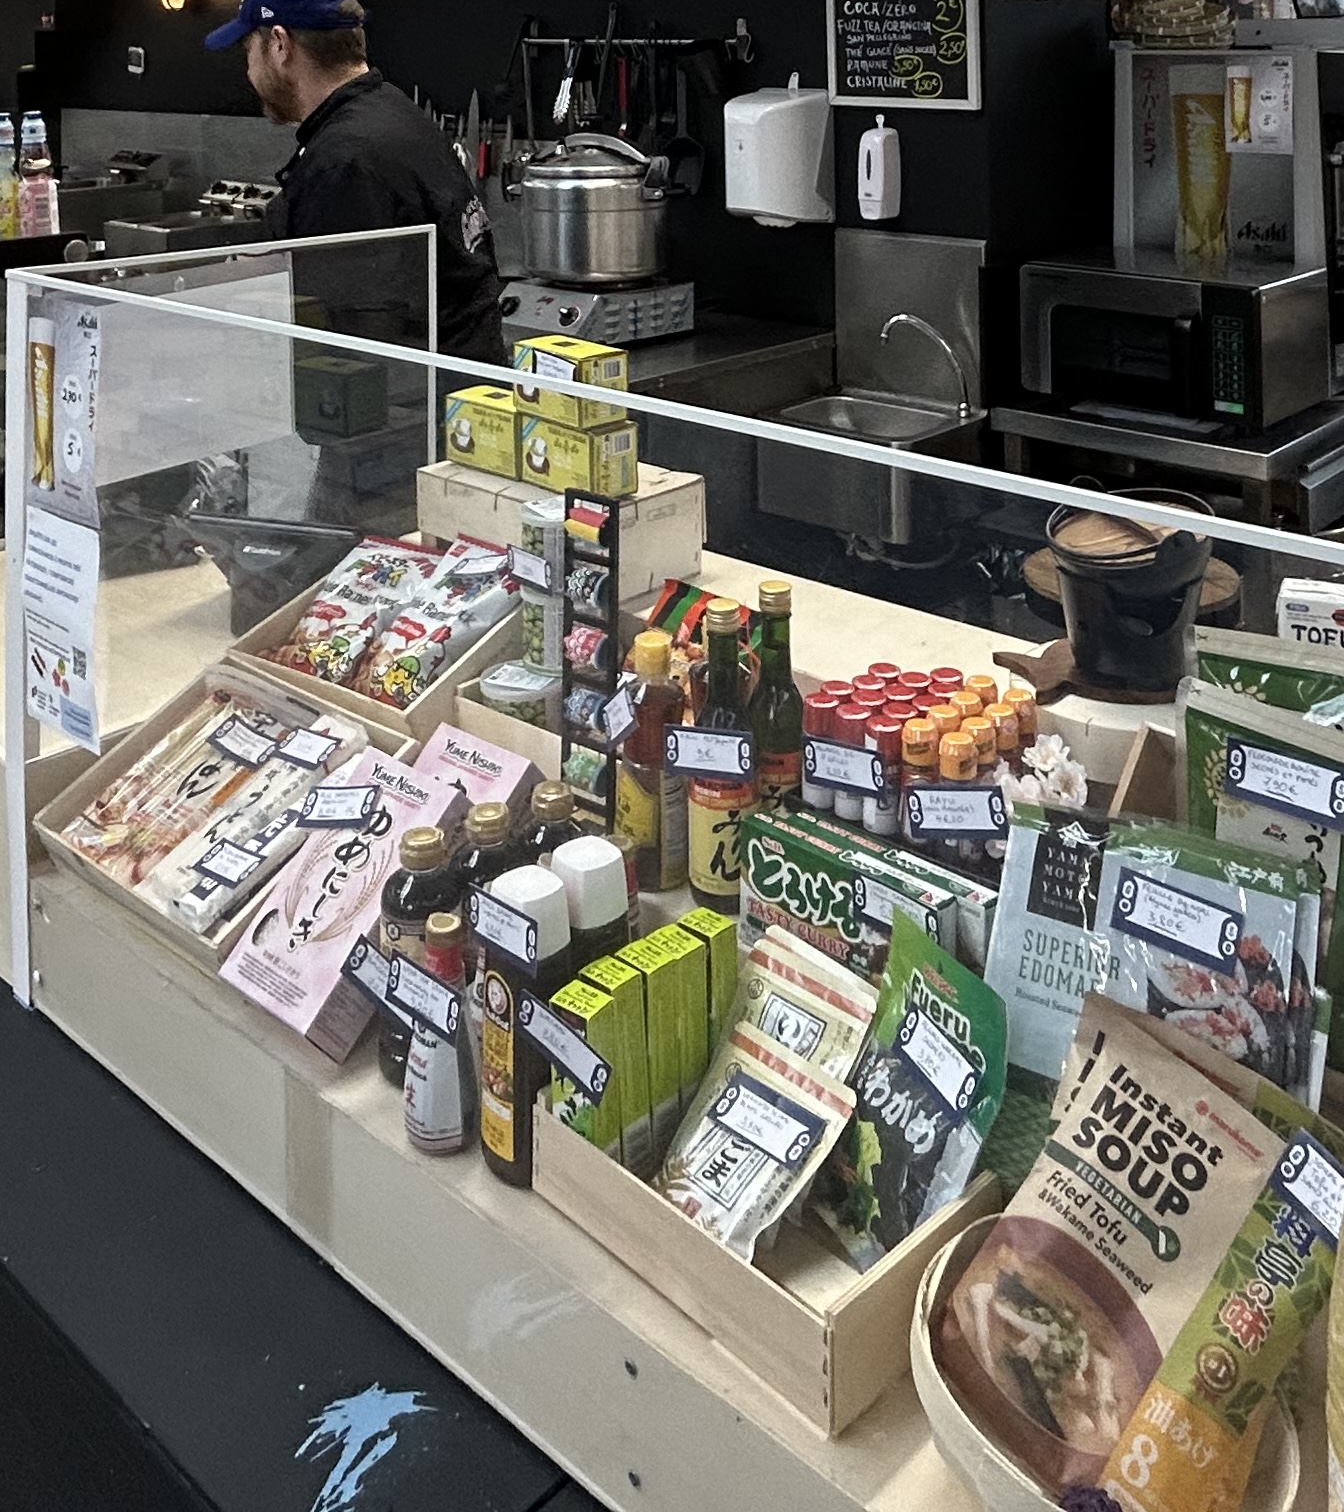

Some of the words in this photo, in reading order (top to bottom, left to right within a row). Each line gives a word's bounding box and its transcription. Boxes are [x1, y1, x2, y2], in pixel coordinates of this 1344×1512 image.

[846, 75, 908, 91] CRISTALINE
[371, 762, 396, 787] YUME
[445, 738, 470, 761] YUME
[747, 896, 793, 929] TASTY
[797, 923, 851, 961] CURRY
[1090, 1085, 1208, 1192] MISO
[1108, 1062, 1224, 1168] Instant
[1071, 1116, 1191, 1217] SOUP
[1074, 1160, 1142, 1225] VEGETARIAN
[1038, 1187, 1094, 1243] &Wakame
[1095, 1238, 1154, 1296] Seaweed
[1046, 1170, 1091, 1212] Fried
[1090, 1200, 1128, 1248] Tofu
[1120, 1433, 1159, 1489] 8
